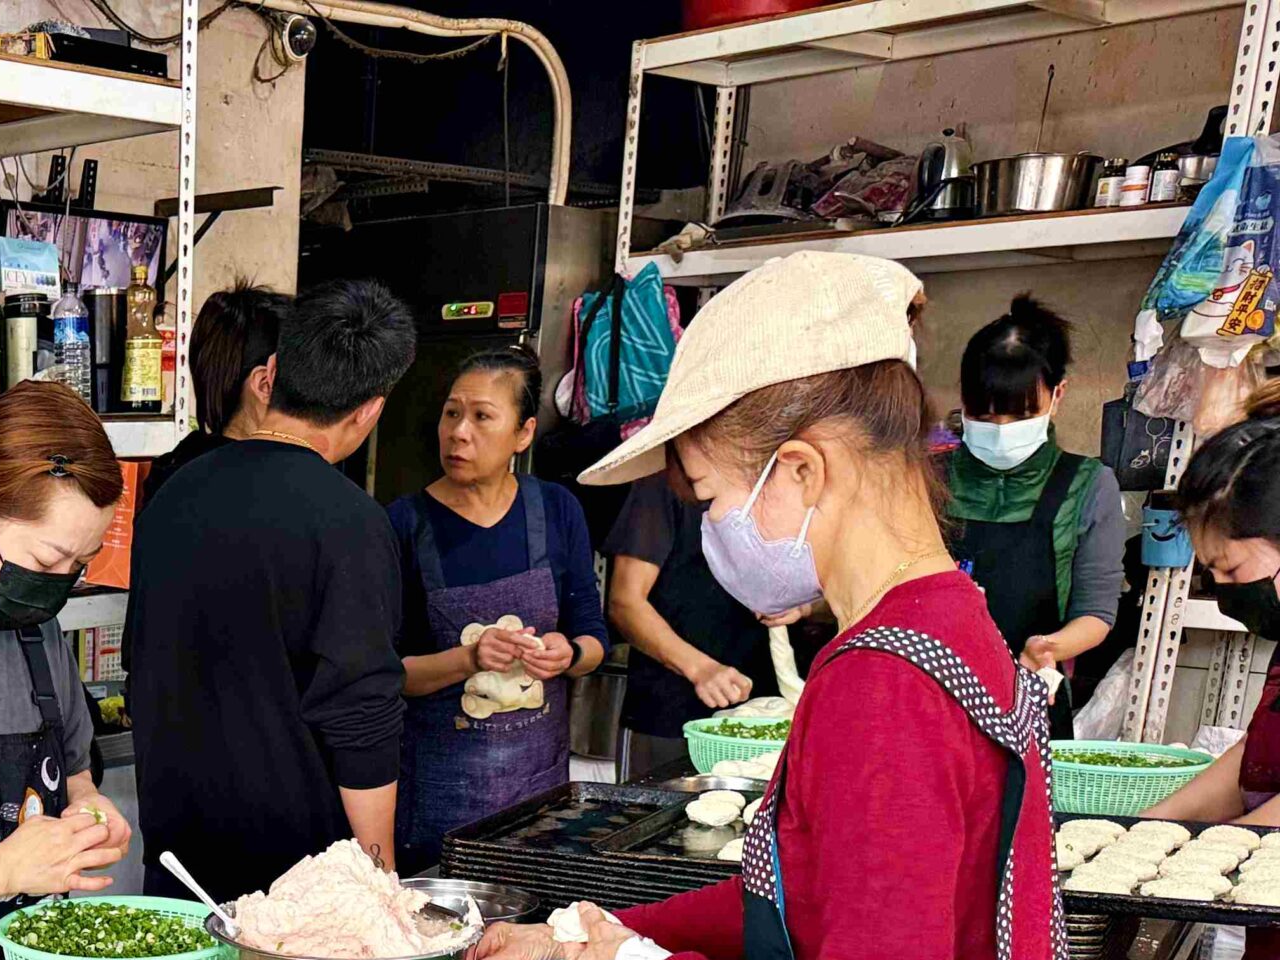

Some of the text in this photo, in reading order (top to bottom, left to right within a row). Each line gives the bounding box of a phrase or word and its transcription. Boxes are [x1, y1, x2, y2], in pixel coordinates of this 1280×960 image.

[3, 270, 27, 284] ICEY
[1227, 278, 1265, 332] 招財平安
